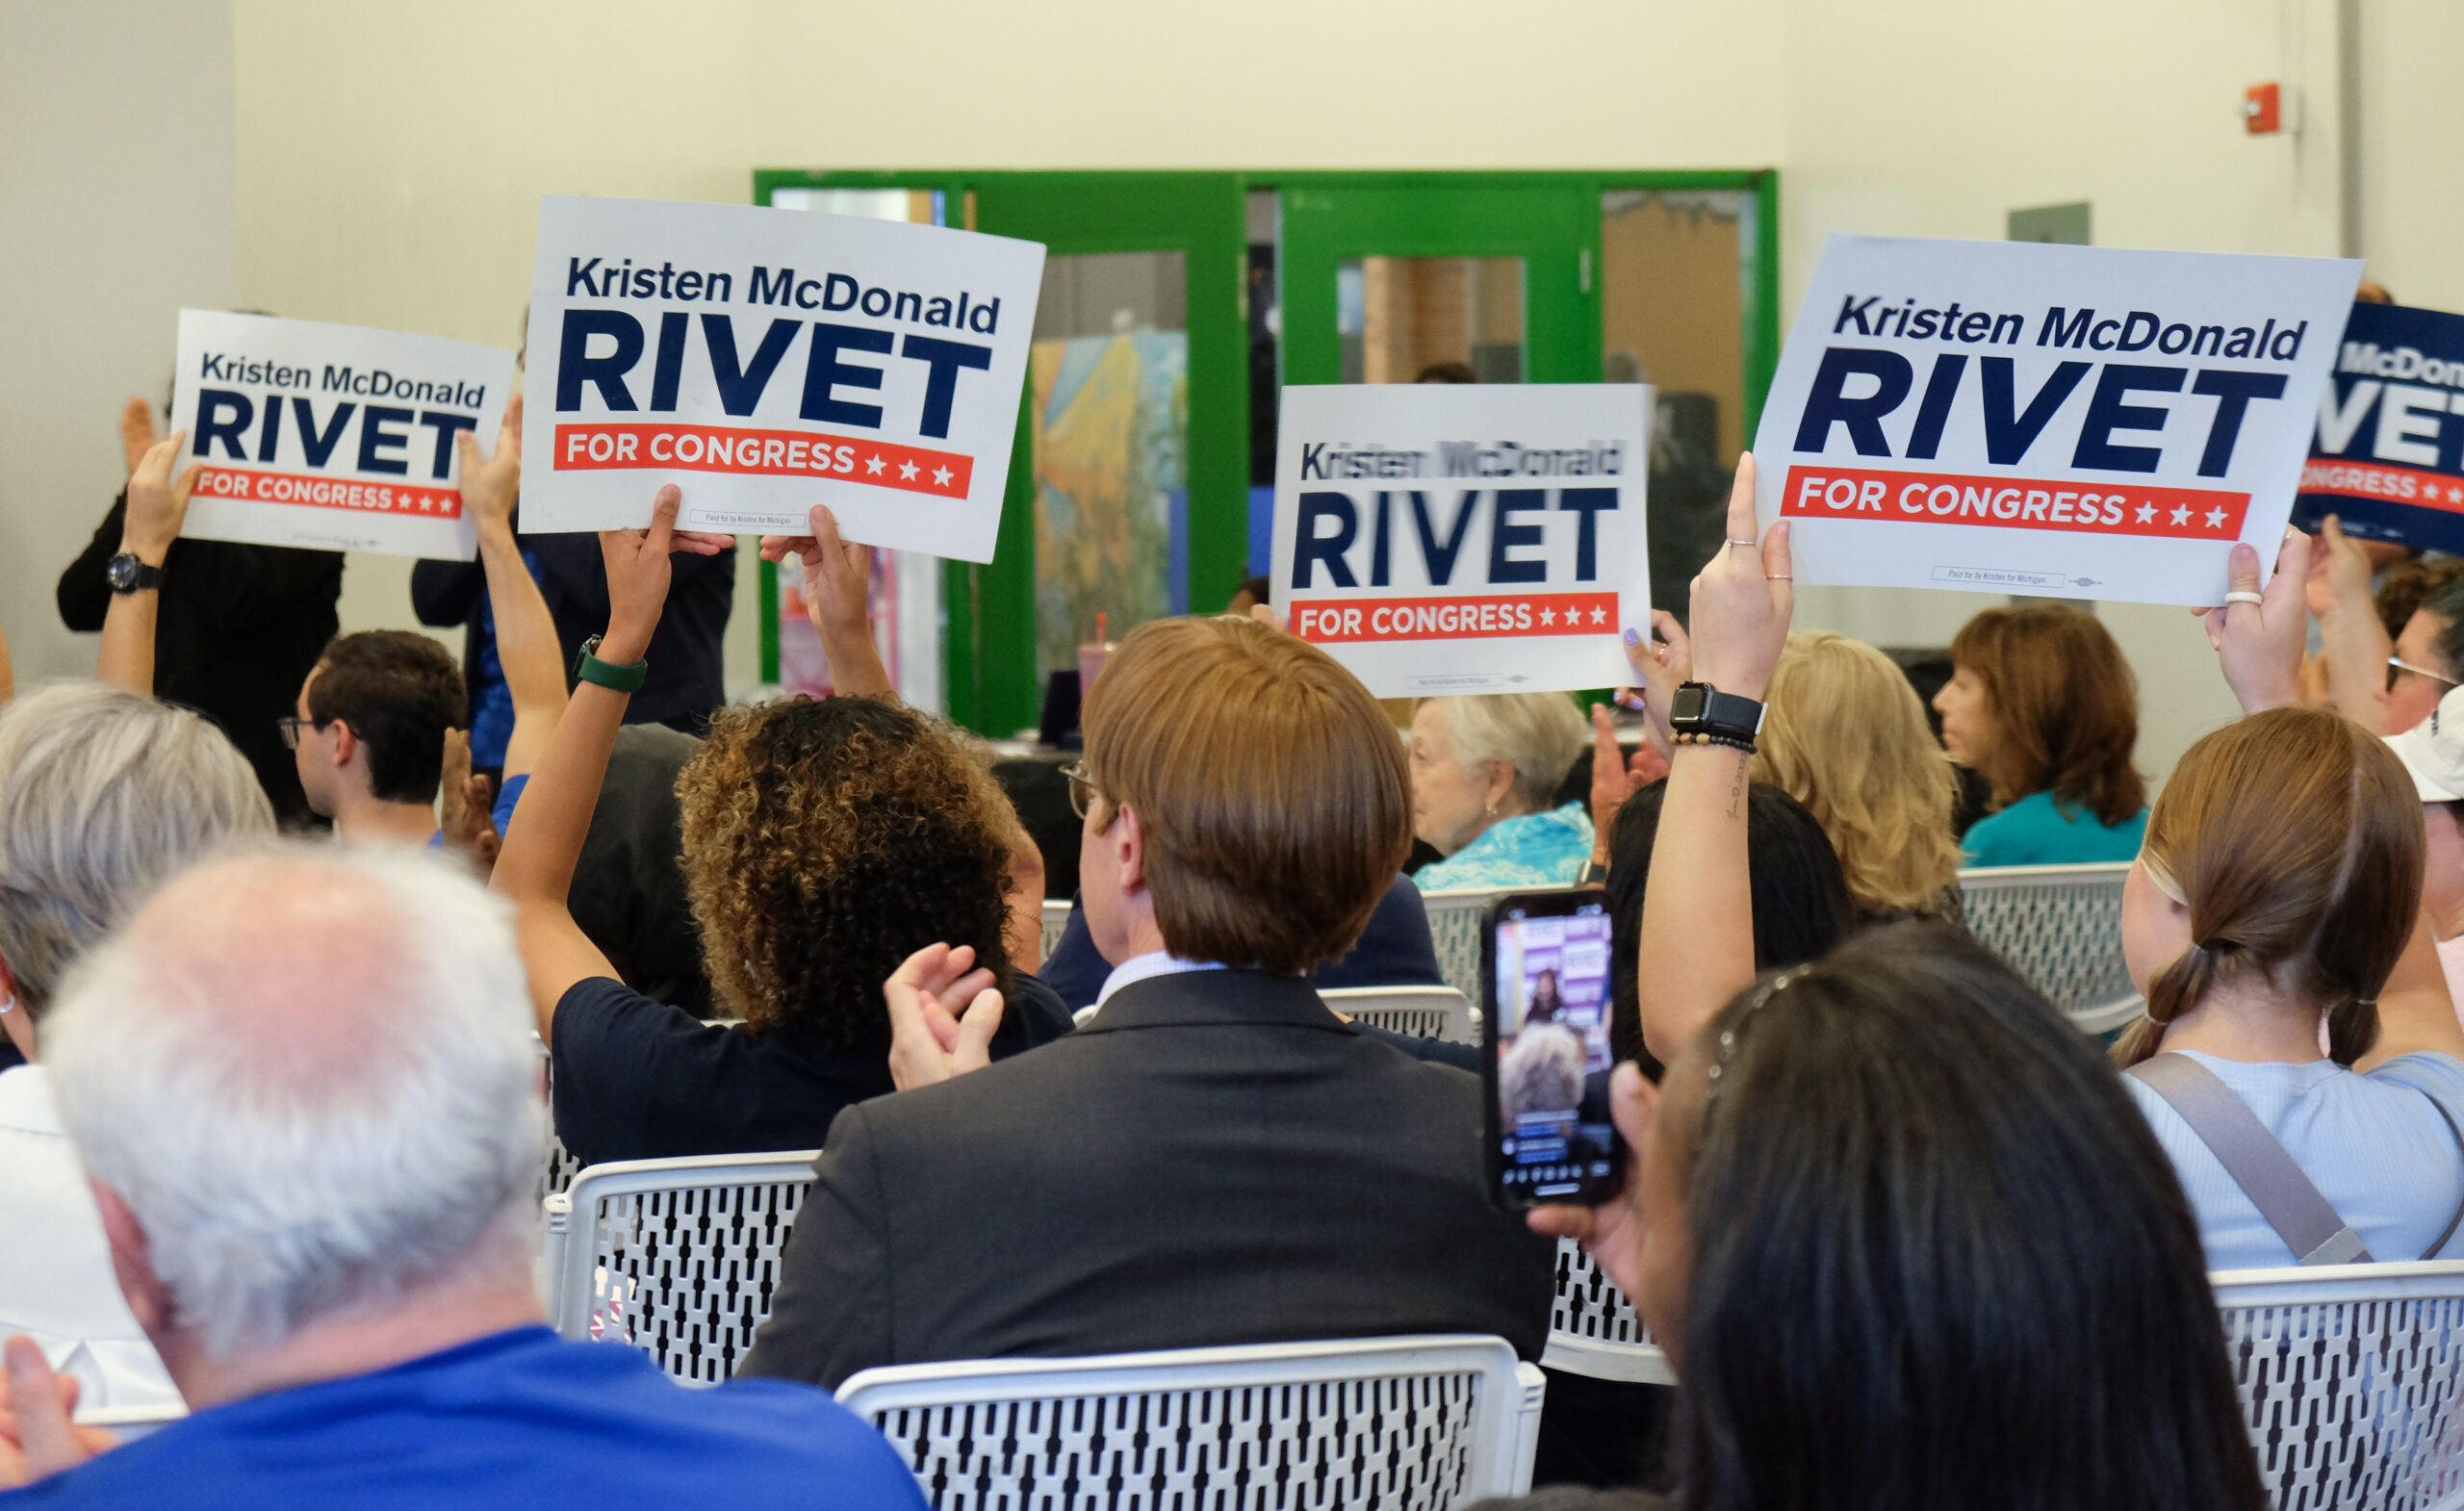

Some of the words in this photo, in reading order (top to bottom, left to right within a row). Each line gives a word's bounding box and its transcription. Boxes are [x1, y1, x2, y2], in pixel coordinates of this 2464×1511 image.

[566, 257, 732, 303] Kristen
[747, 266, 1001, 336] McDonald
[1834, 295, 2025, 346] Kristen
[2036, 306, 2309, 361] McDonald
[201, 352, 311, 389] Kristen
[322, 365, 485, 409] McDonald
[555, 309, 993, 440] RIVET
[192, 388, 478, 480] RIVET
[1792, 346, 2290, 478] RIVET
[2315, 377, 2464, 473] VE
[567, 433, 639, 463] FOR
[650, 433, 856, 474] CONGRESS
[197, 472, 249, 497] FOR
[256, 476, 392, 509] CONGRESS
[737, 515, 757, 524] Kristen
[1797, 476, 1887, 512] FOR
[1899, 482, 2127, 525] CONGRESS
[1292, 487, 1619, 590] RIVET
[1299, 607, 1363, 636] FOR
[1371, 602, 1532, 634] CONGRESS
